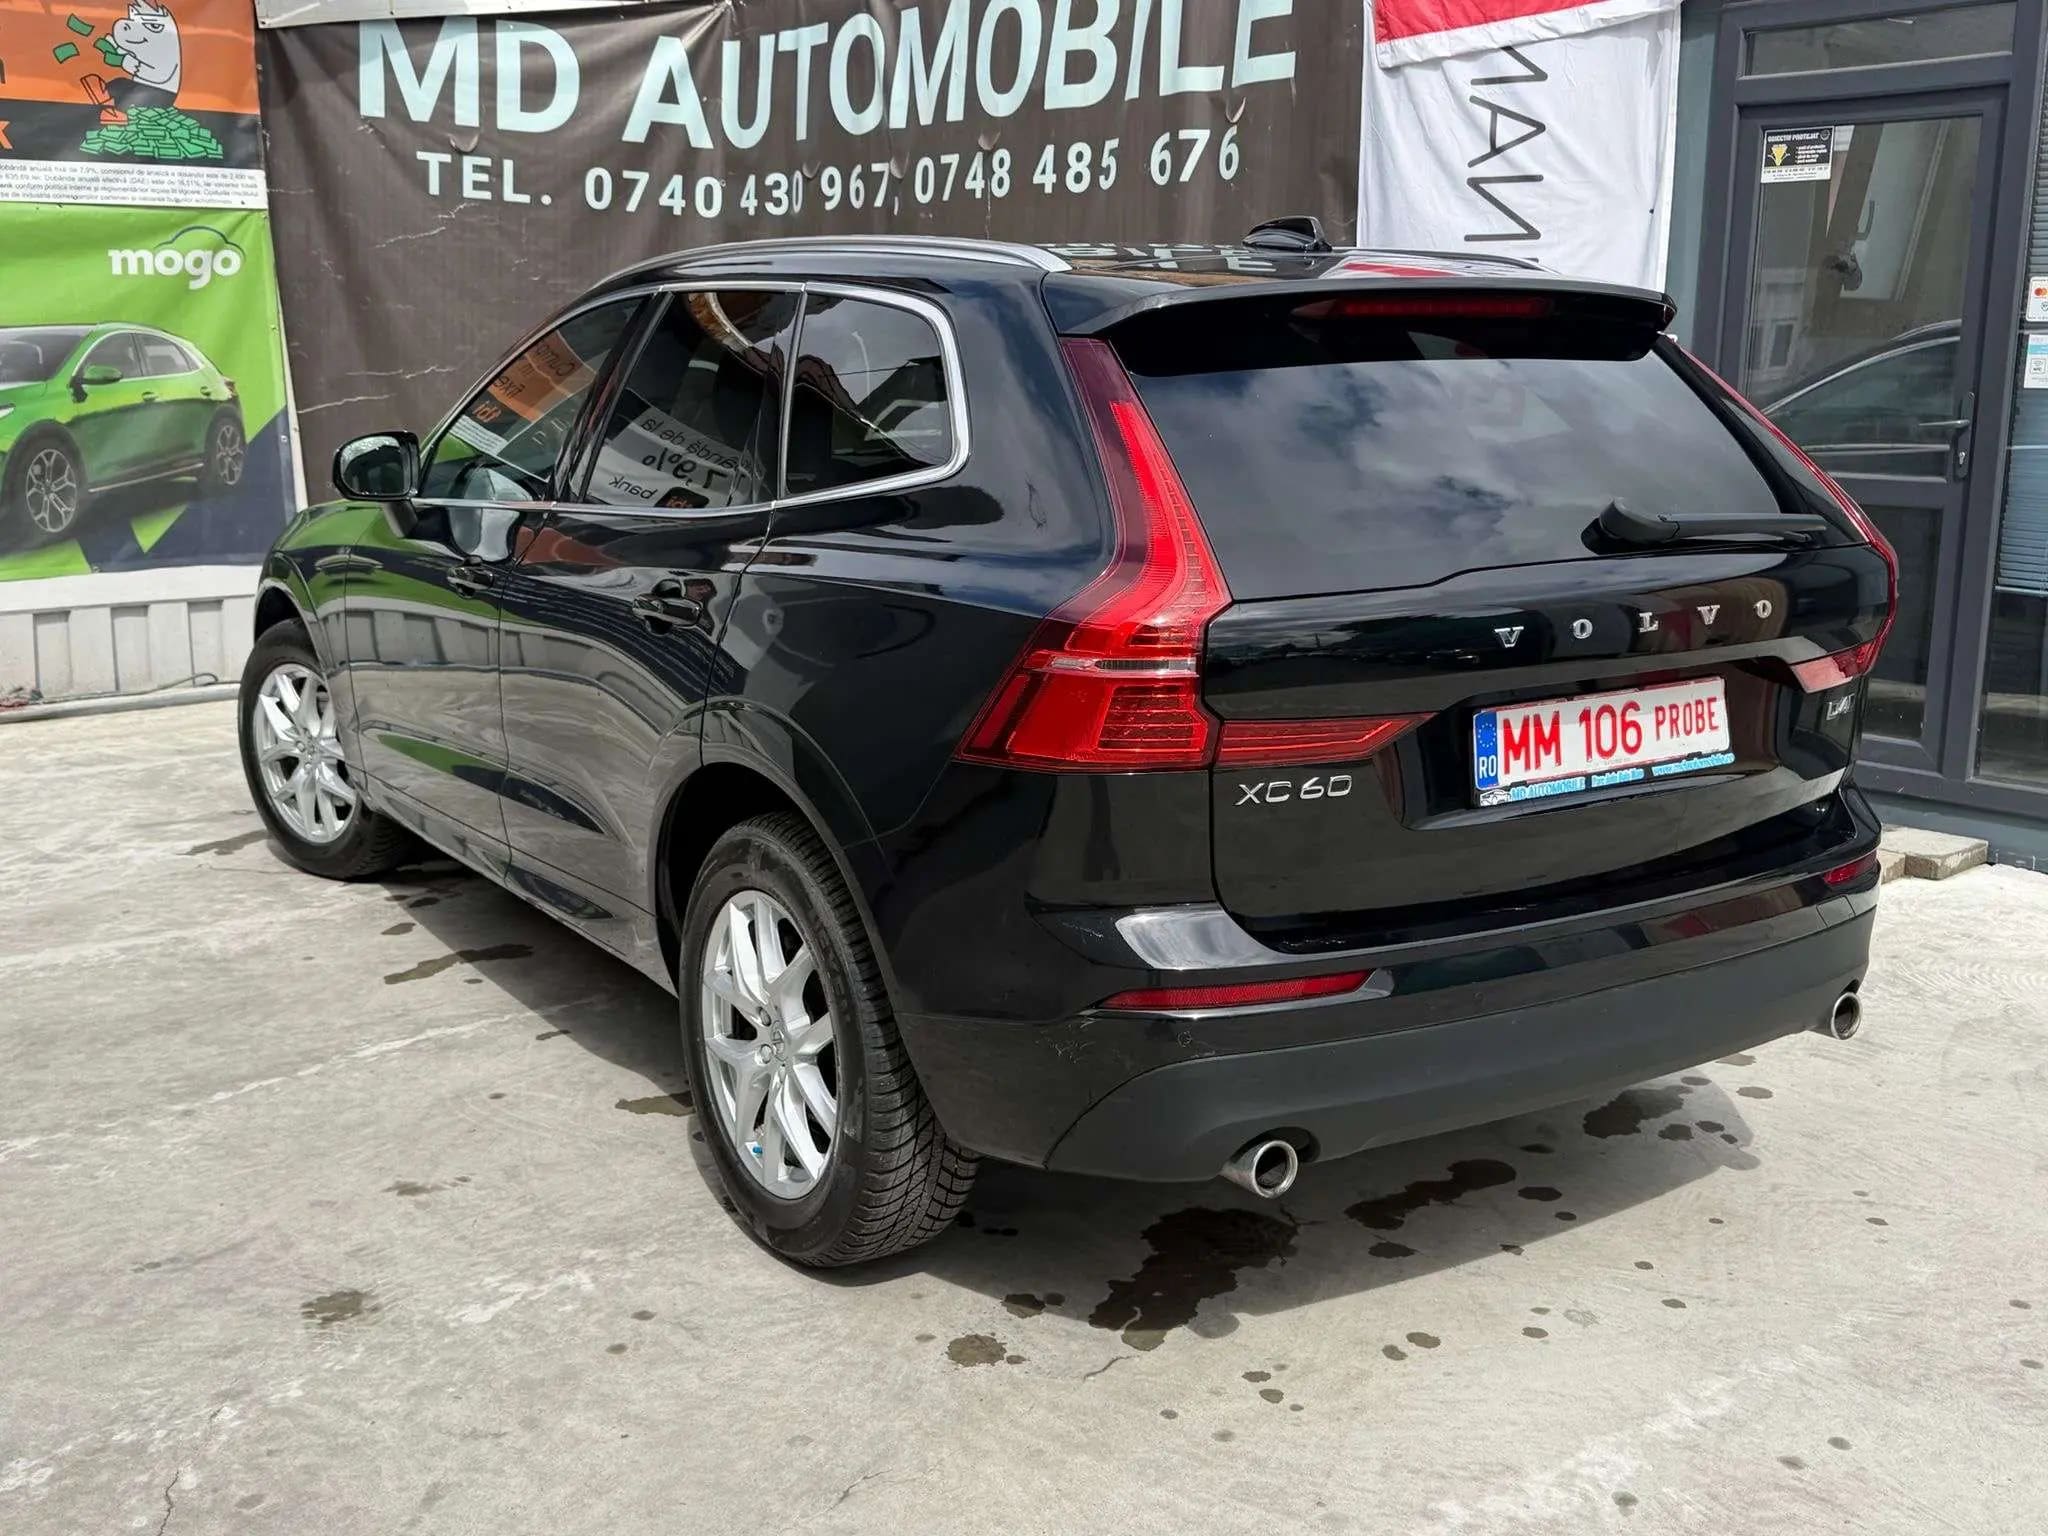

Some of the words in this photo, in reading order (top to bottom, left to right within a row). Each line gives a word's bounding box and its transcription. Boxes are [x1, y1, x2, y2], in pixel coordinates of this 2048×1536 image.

[359, 16, 580, 133] MD
[622, 0, 1297, 149] AUTOMOBILE
[416, 151, 552, 205] TEL.
[584, 167, 723, 218] 0740
[739, 171, 803, 216] 430
[914, 147, 1012, 204] 0748
[1032, 137, 1120, 194] 485
[1149, 124, 1241, 187] 676
[108, 248, 242, 290] mogo
[1494, 599, 1774, 648] VOLVO
[1479, 755, 1498, 779] RO
[1503, 710, 1562, 775] MM
[1579, 700, 1644, 763] 106
[1655, 696, 1720, 740] PROBE
